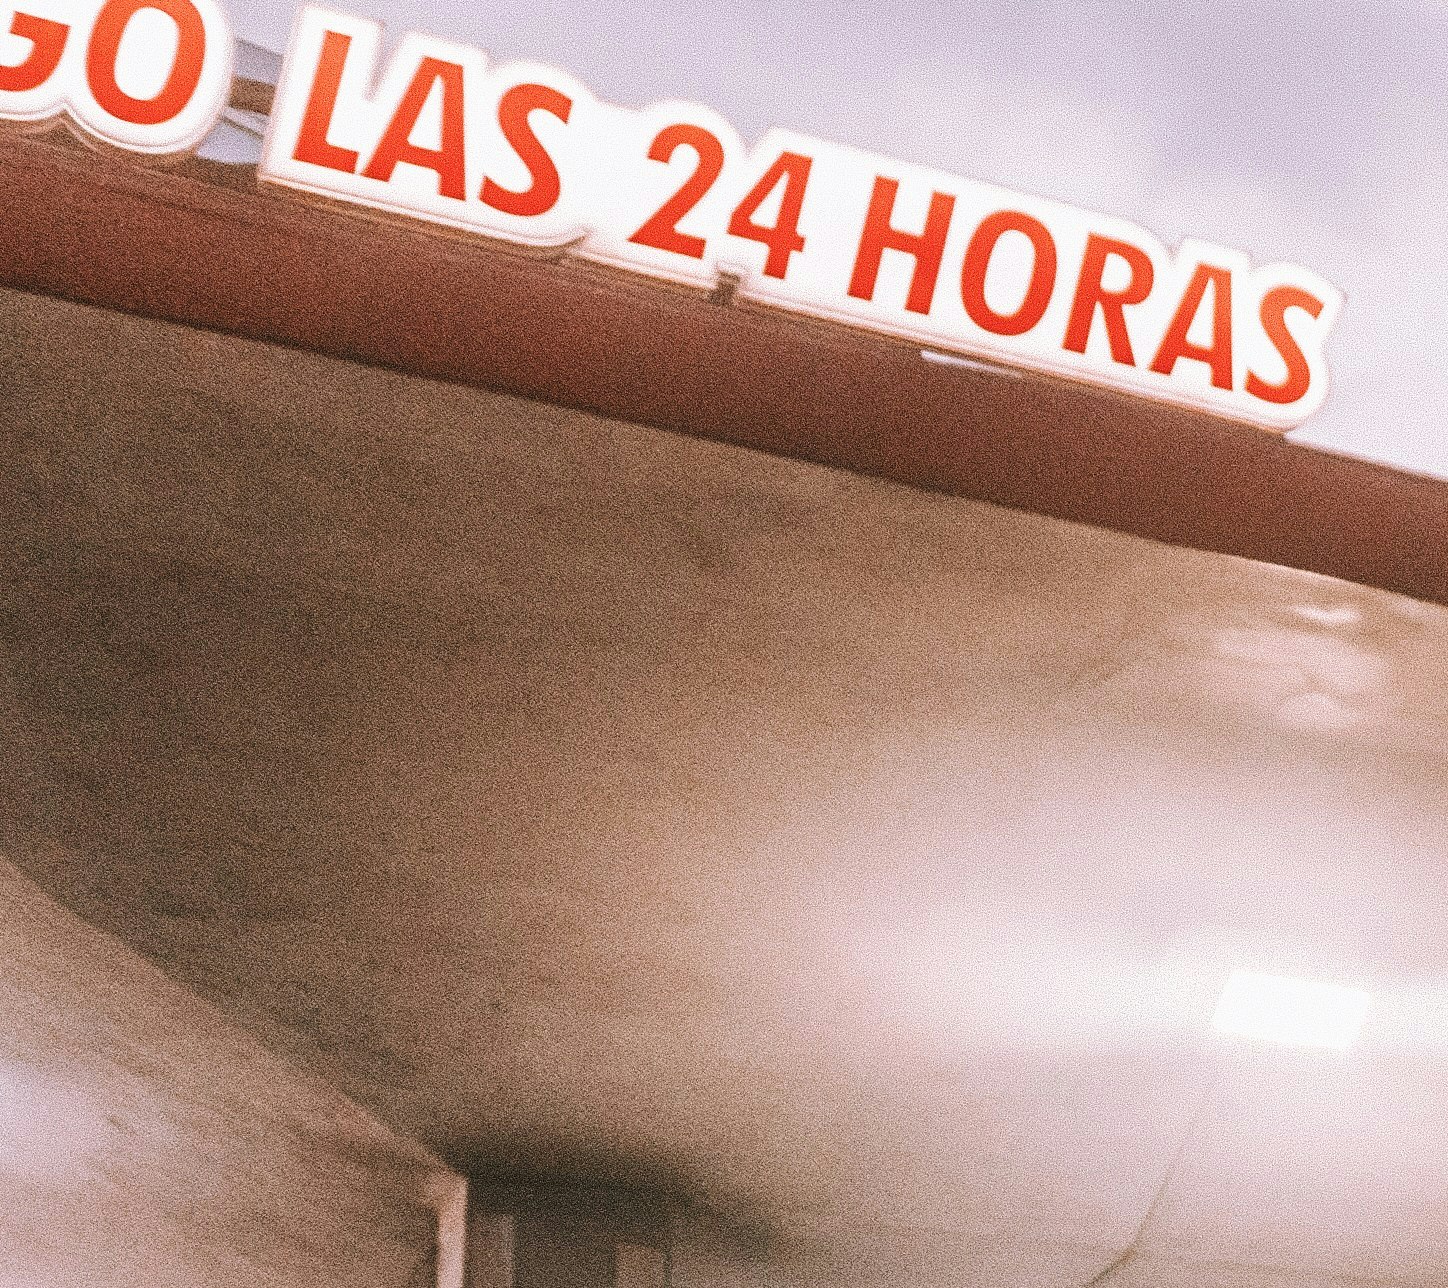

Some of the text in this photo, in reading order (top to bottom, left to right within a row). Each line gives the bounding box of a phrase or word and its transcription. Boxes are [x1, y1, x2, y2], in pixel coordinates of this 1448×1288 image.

[292, 30, 573, 218] LAS
[628, 123, 813, 280] 24
[847, 175, 1324, 405] HORAS
